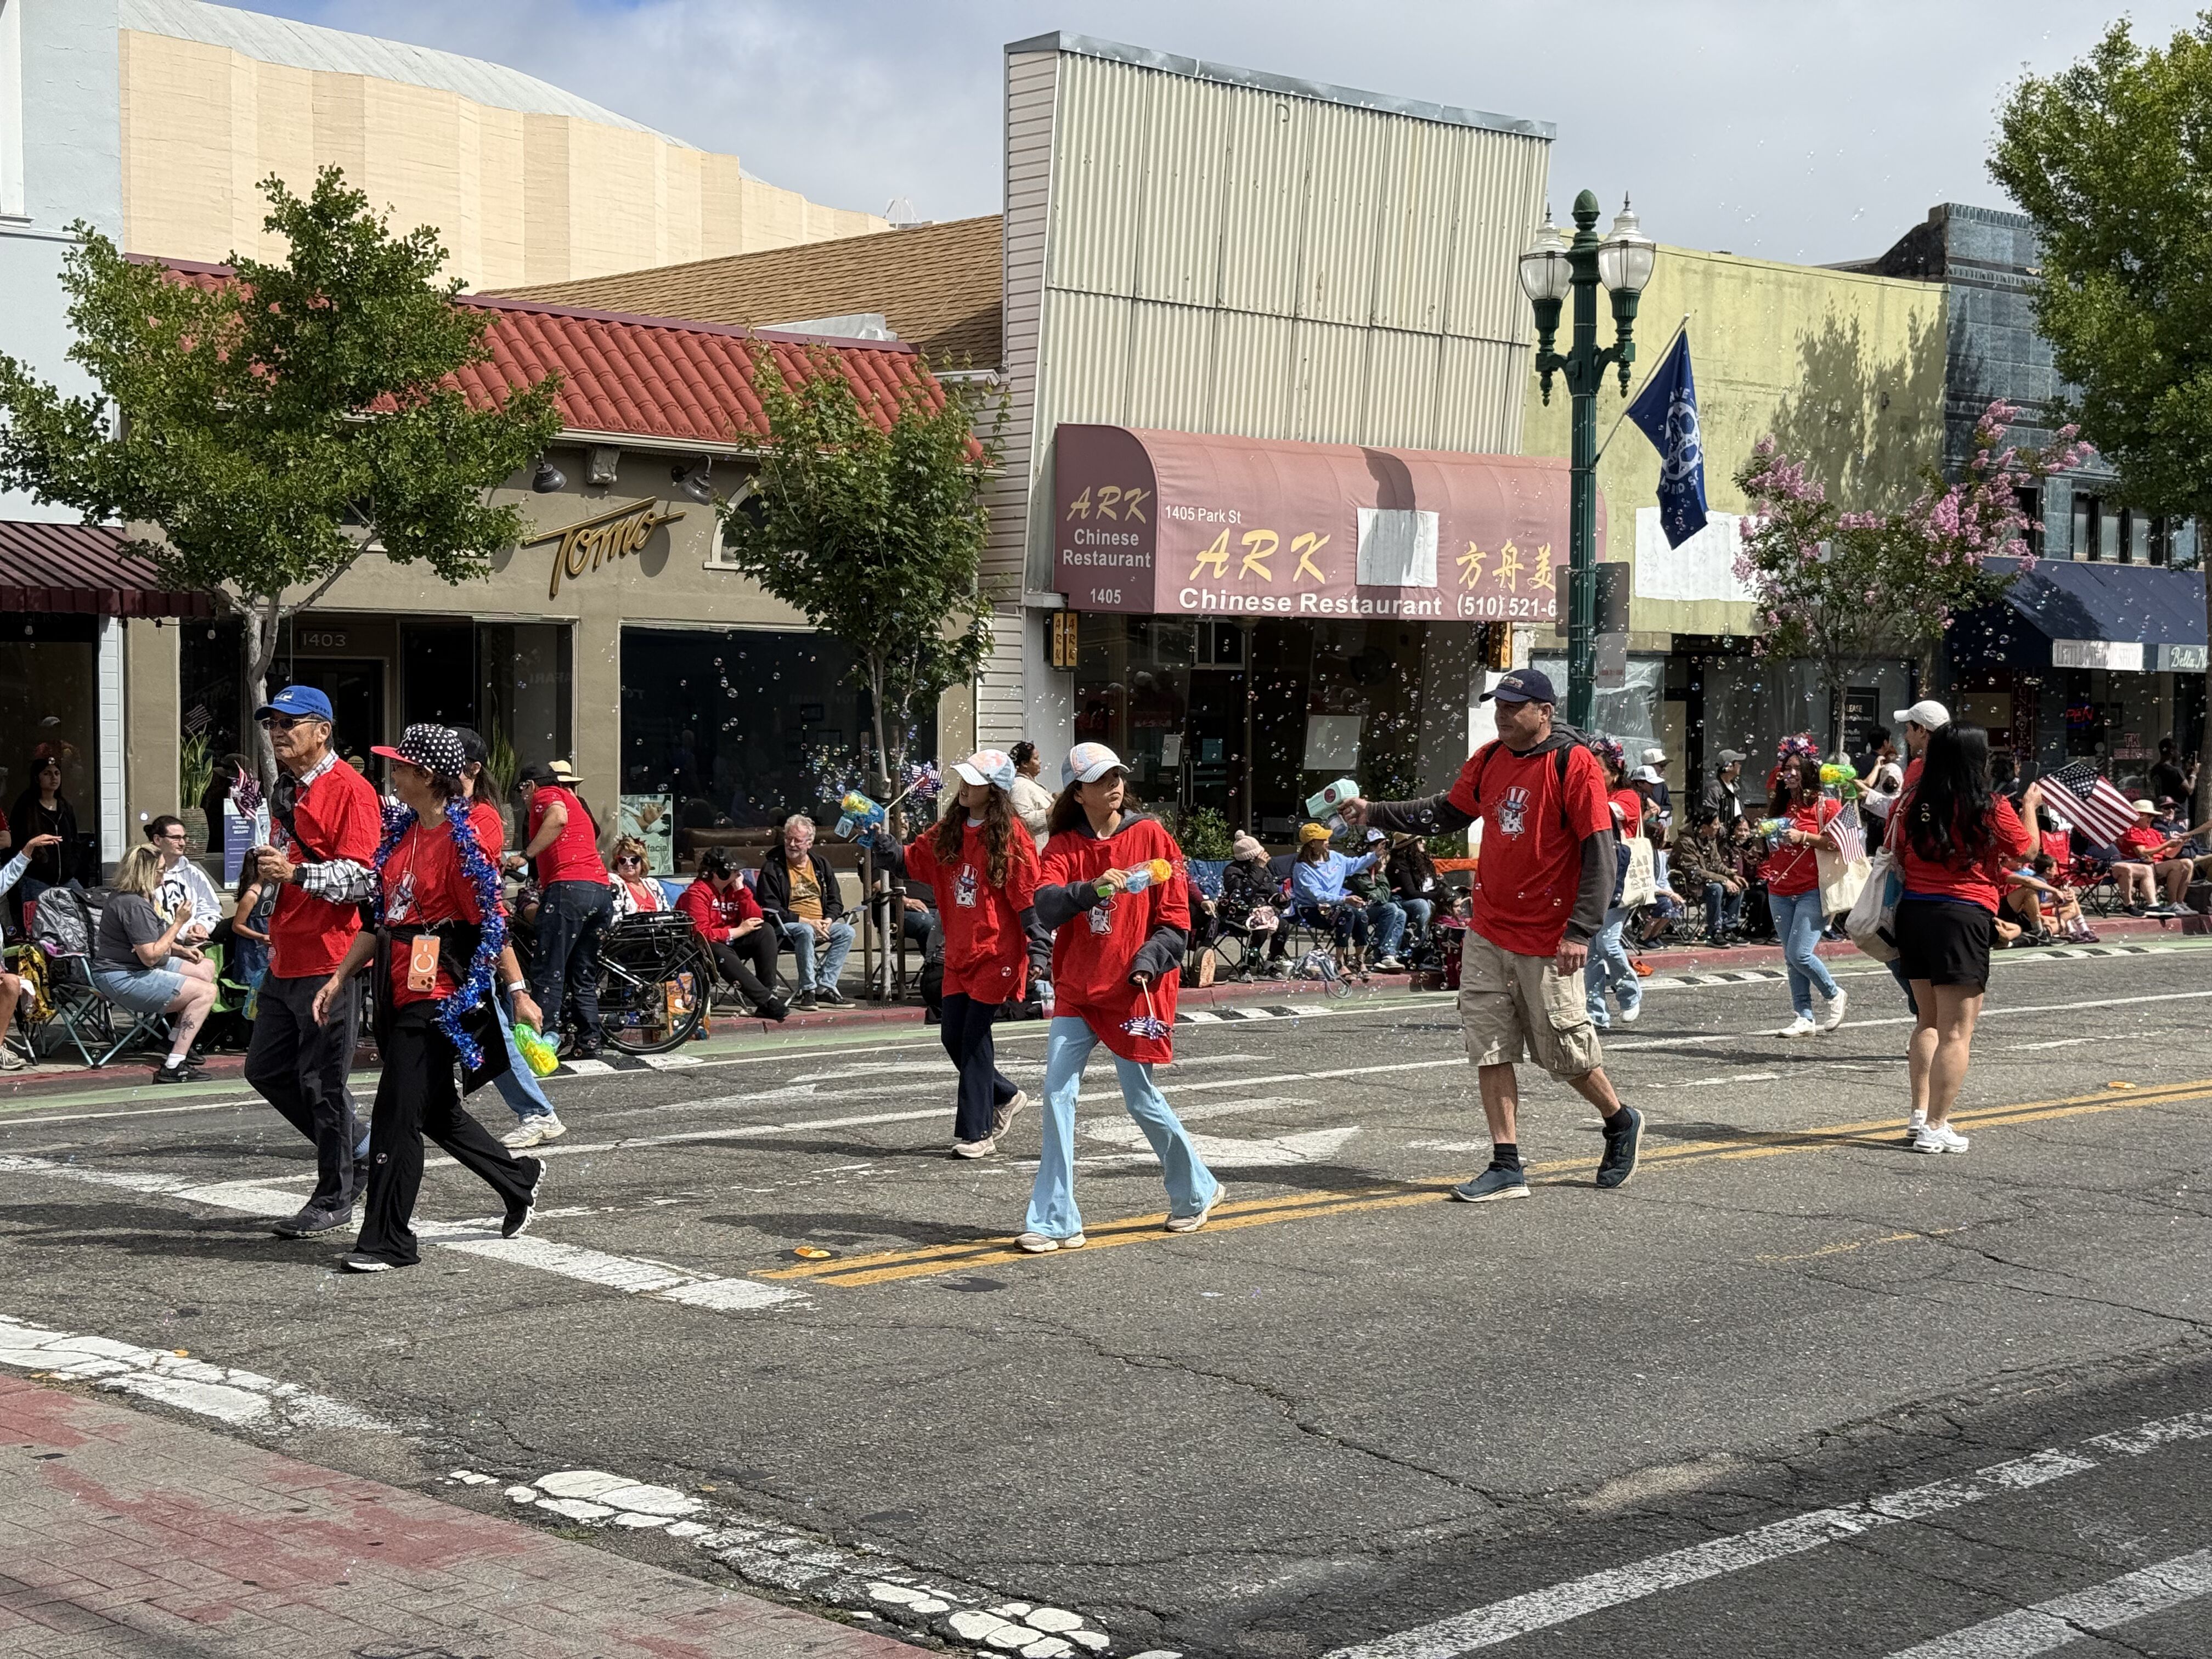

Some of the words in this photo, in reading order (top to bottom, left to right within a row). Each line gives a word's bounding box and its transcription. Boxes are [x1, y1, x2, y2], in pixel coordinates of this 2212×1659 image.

[1066, 486, 1151, 524] ARK
[1165, 505, 1195, 521] 1405
[1198, 508, 1226, 523] Park
[1228, 510, 1242, 524] St
[522, 496, 687, 598] Tomo
[1074, 528, 1138, 546] Chinese
[1063, 549, 1151, 568] Restaurant
[1189, 527, 1331, 584] ARK
[1090, 588, 1121, 604] 1405
[1180, 588, 1291, 612] Chinese
[1301, 593, 1442, 615] Restaurant
[1457, 594, 1503, 618] (510)
[304, 633, 347, 647] 1403
[2171, 647, 2195, 668] Bella
[2124, 733, 2141, 748] TK
